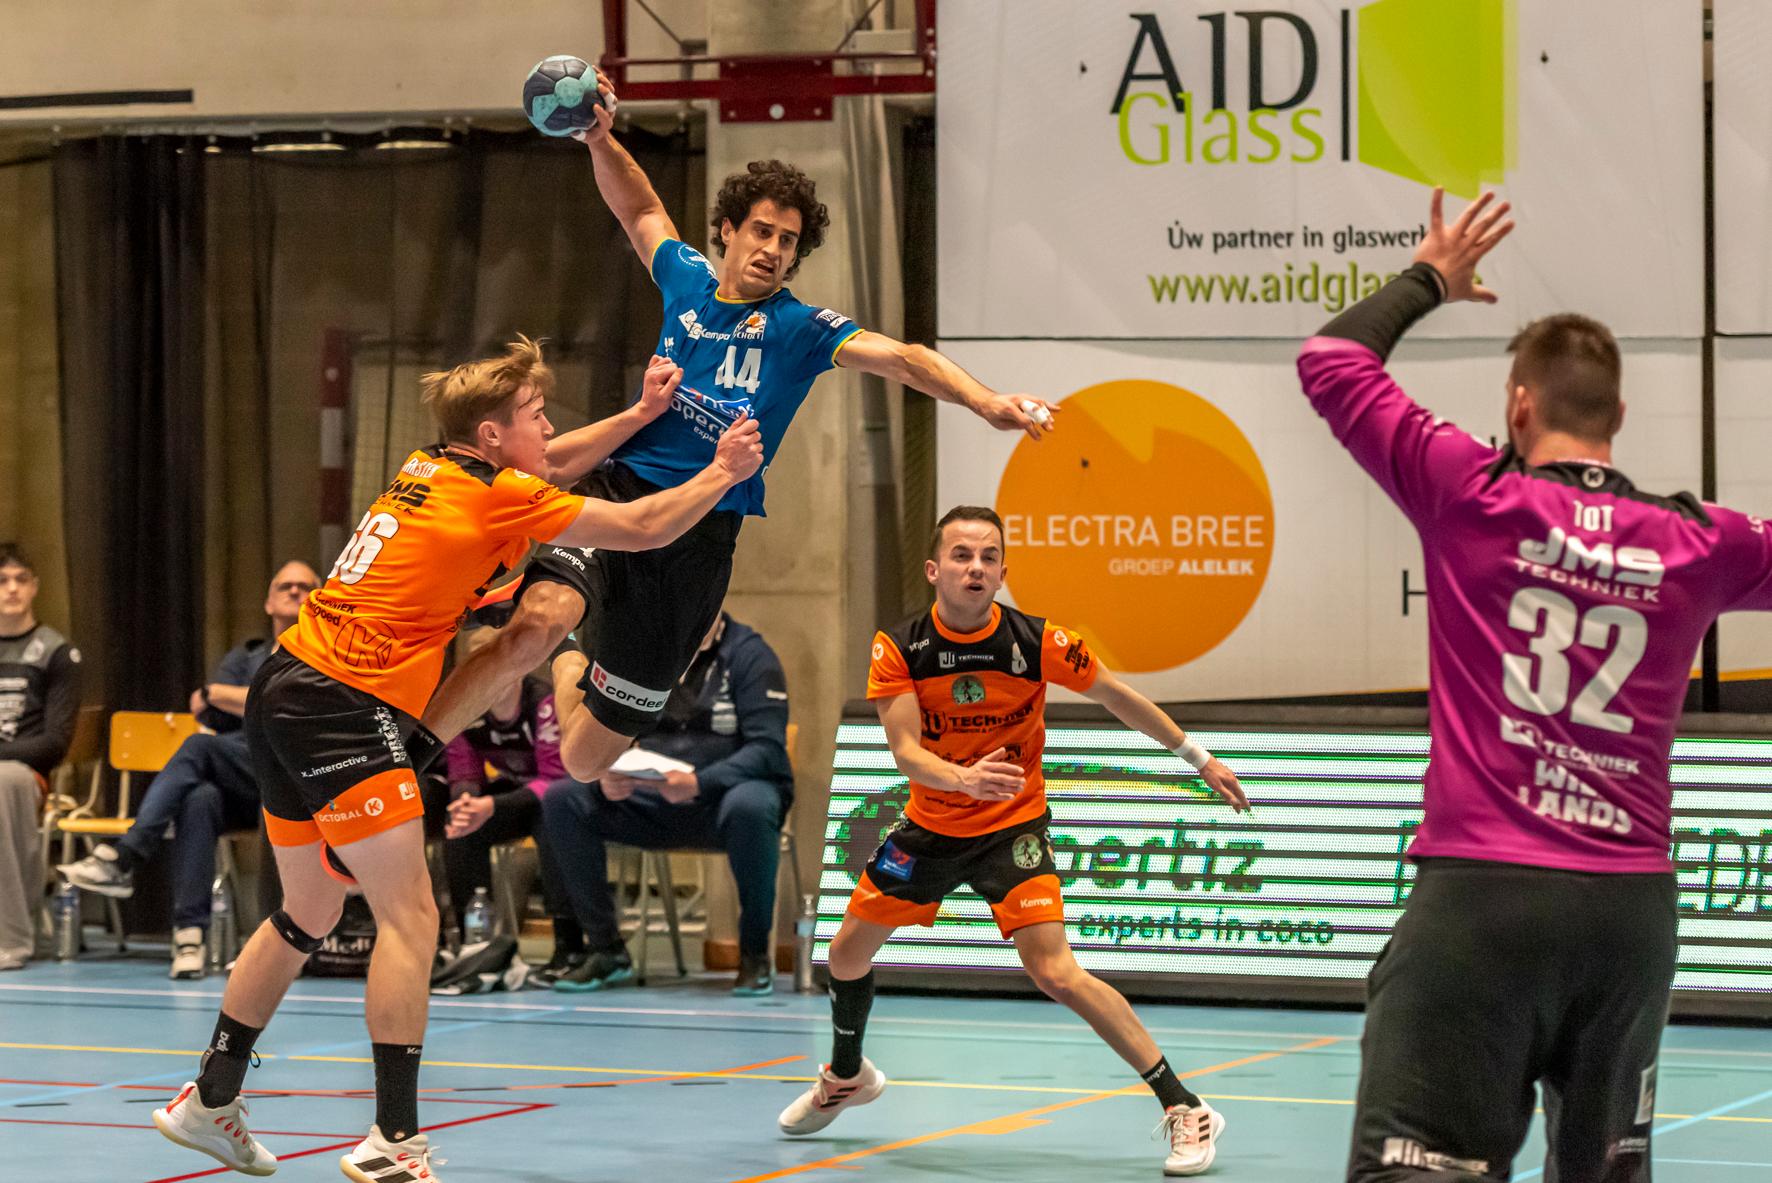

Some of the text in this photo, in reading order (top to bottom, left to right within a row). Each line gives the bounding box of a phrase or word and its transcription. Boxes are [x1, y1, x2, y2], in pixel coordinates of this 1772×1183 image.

[1110, 11, 1318, 114] AID
[1119, 92, 1325, 165] Glass
[1213, 228, 1295, 253] partner
[1303, 226, 1323, 248] in
[1333, 225, 1428, 253] glaswer
[1147, 262, 1400, 313] www.aidgla
[714, 345, 762, 394] 44
[382, 479, 431, 508] MS
[1005, 515, 1265, 548] ELECTRA BREE
[552, 547, 587, 572] Kempa
[1108, 558, 1255, 576] GROEP ALELEK
[1518, 526, 1666, 587] JMS
[1513, 558, 1661, 603] TECHNIEK
[1501, 586, 1649, 734] 32
[1020, 897, 1054, 909] Kempa
